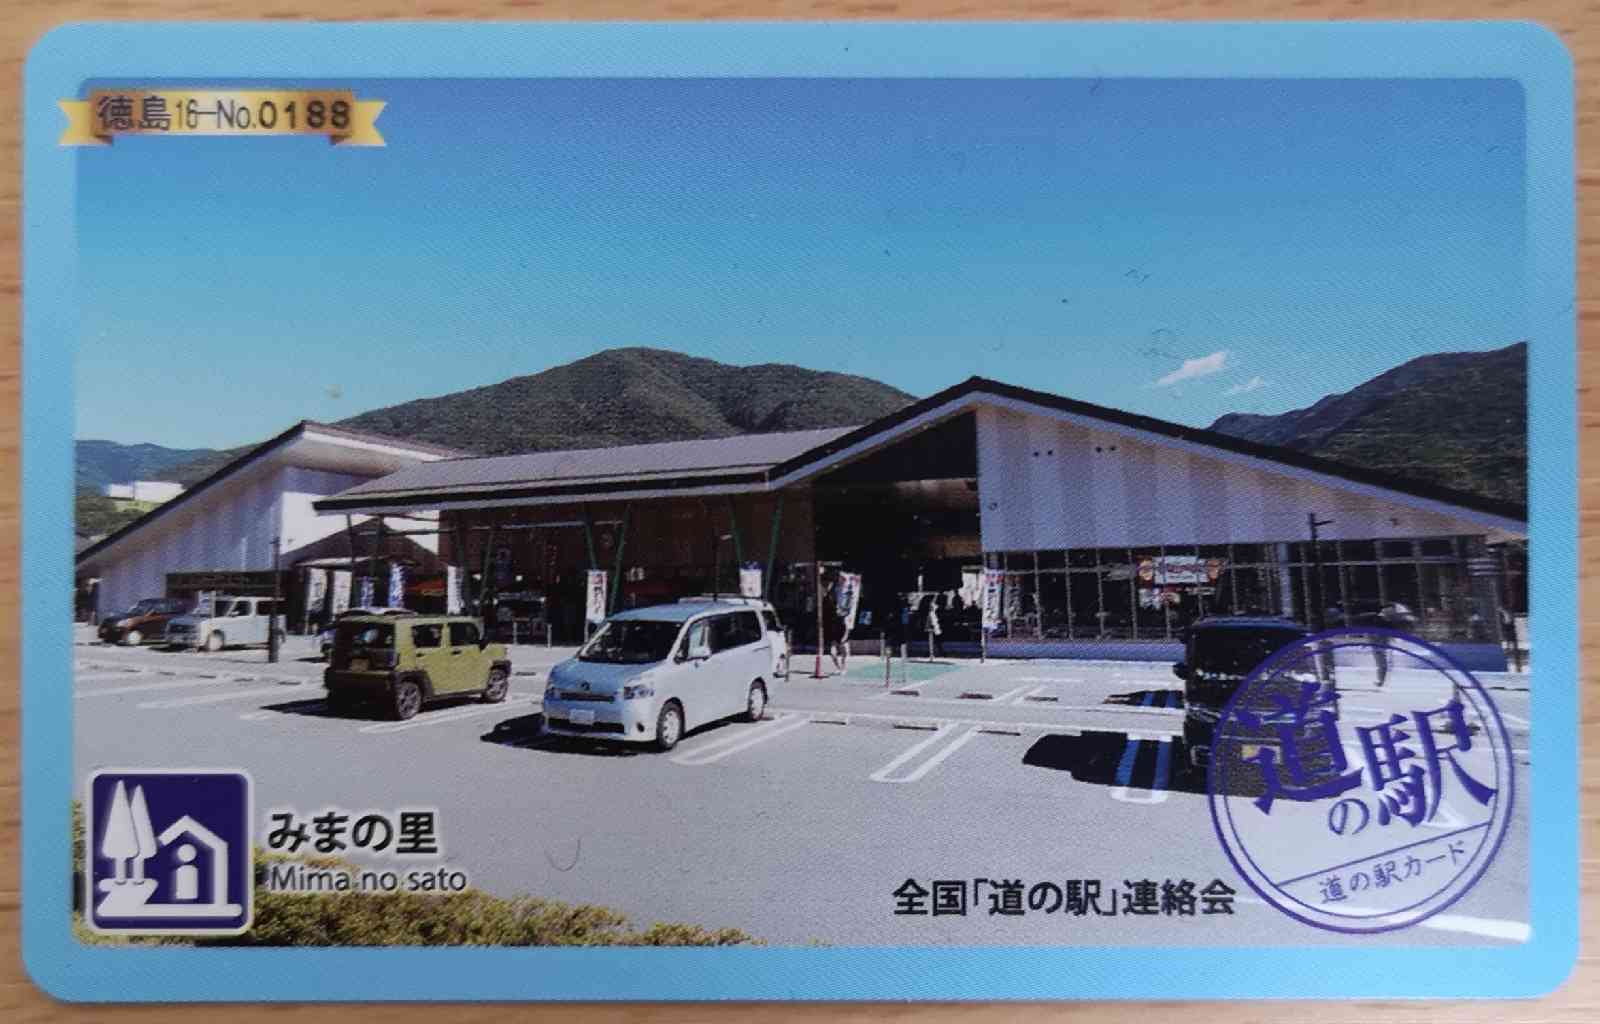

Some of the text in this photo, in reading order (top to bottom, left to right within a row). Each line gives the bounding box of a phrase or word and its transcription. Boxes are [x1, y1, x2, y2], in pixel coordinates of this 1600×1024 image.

[267, 811, 438, 853] みまの里
[270, 866, 467, 891] Mima no sato
[1319, 840, 1465, 904] 道の駅カード
[893, 878, 1236, 917] 全国「道の駅」連絡会
